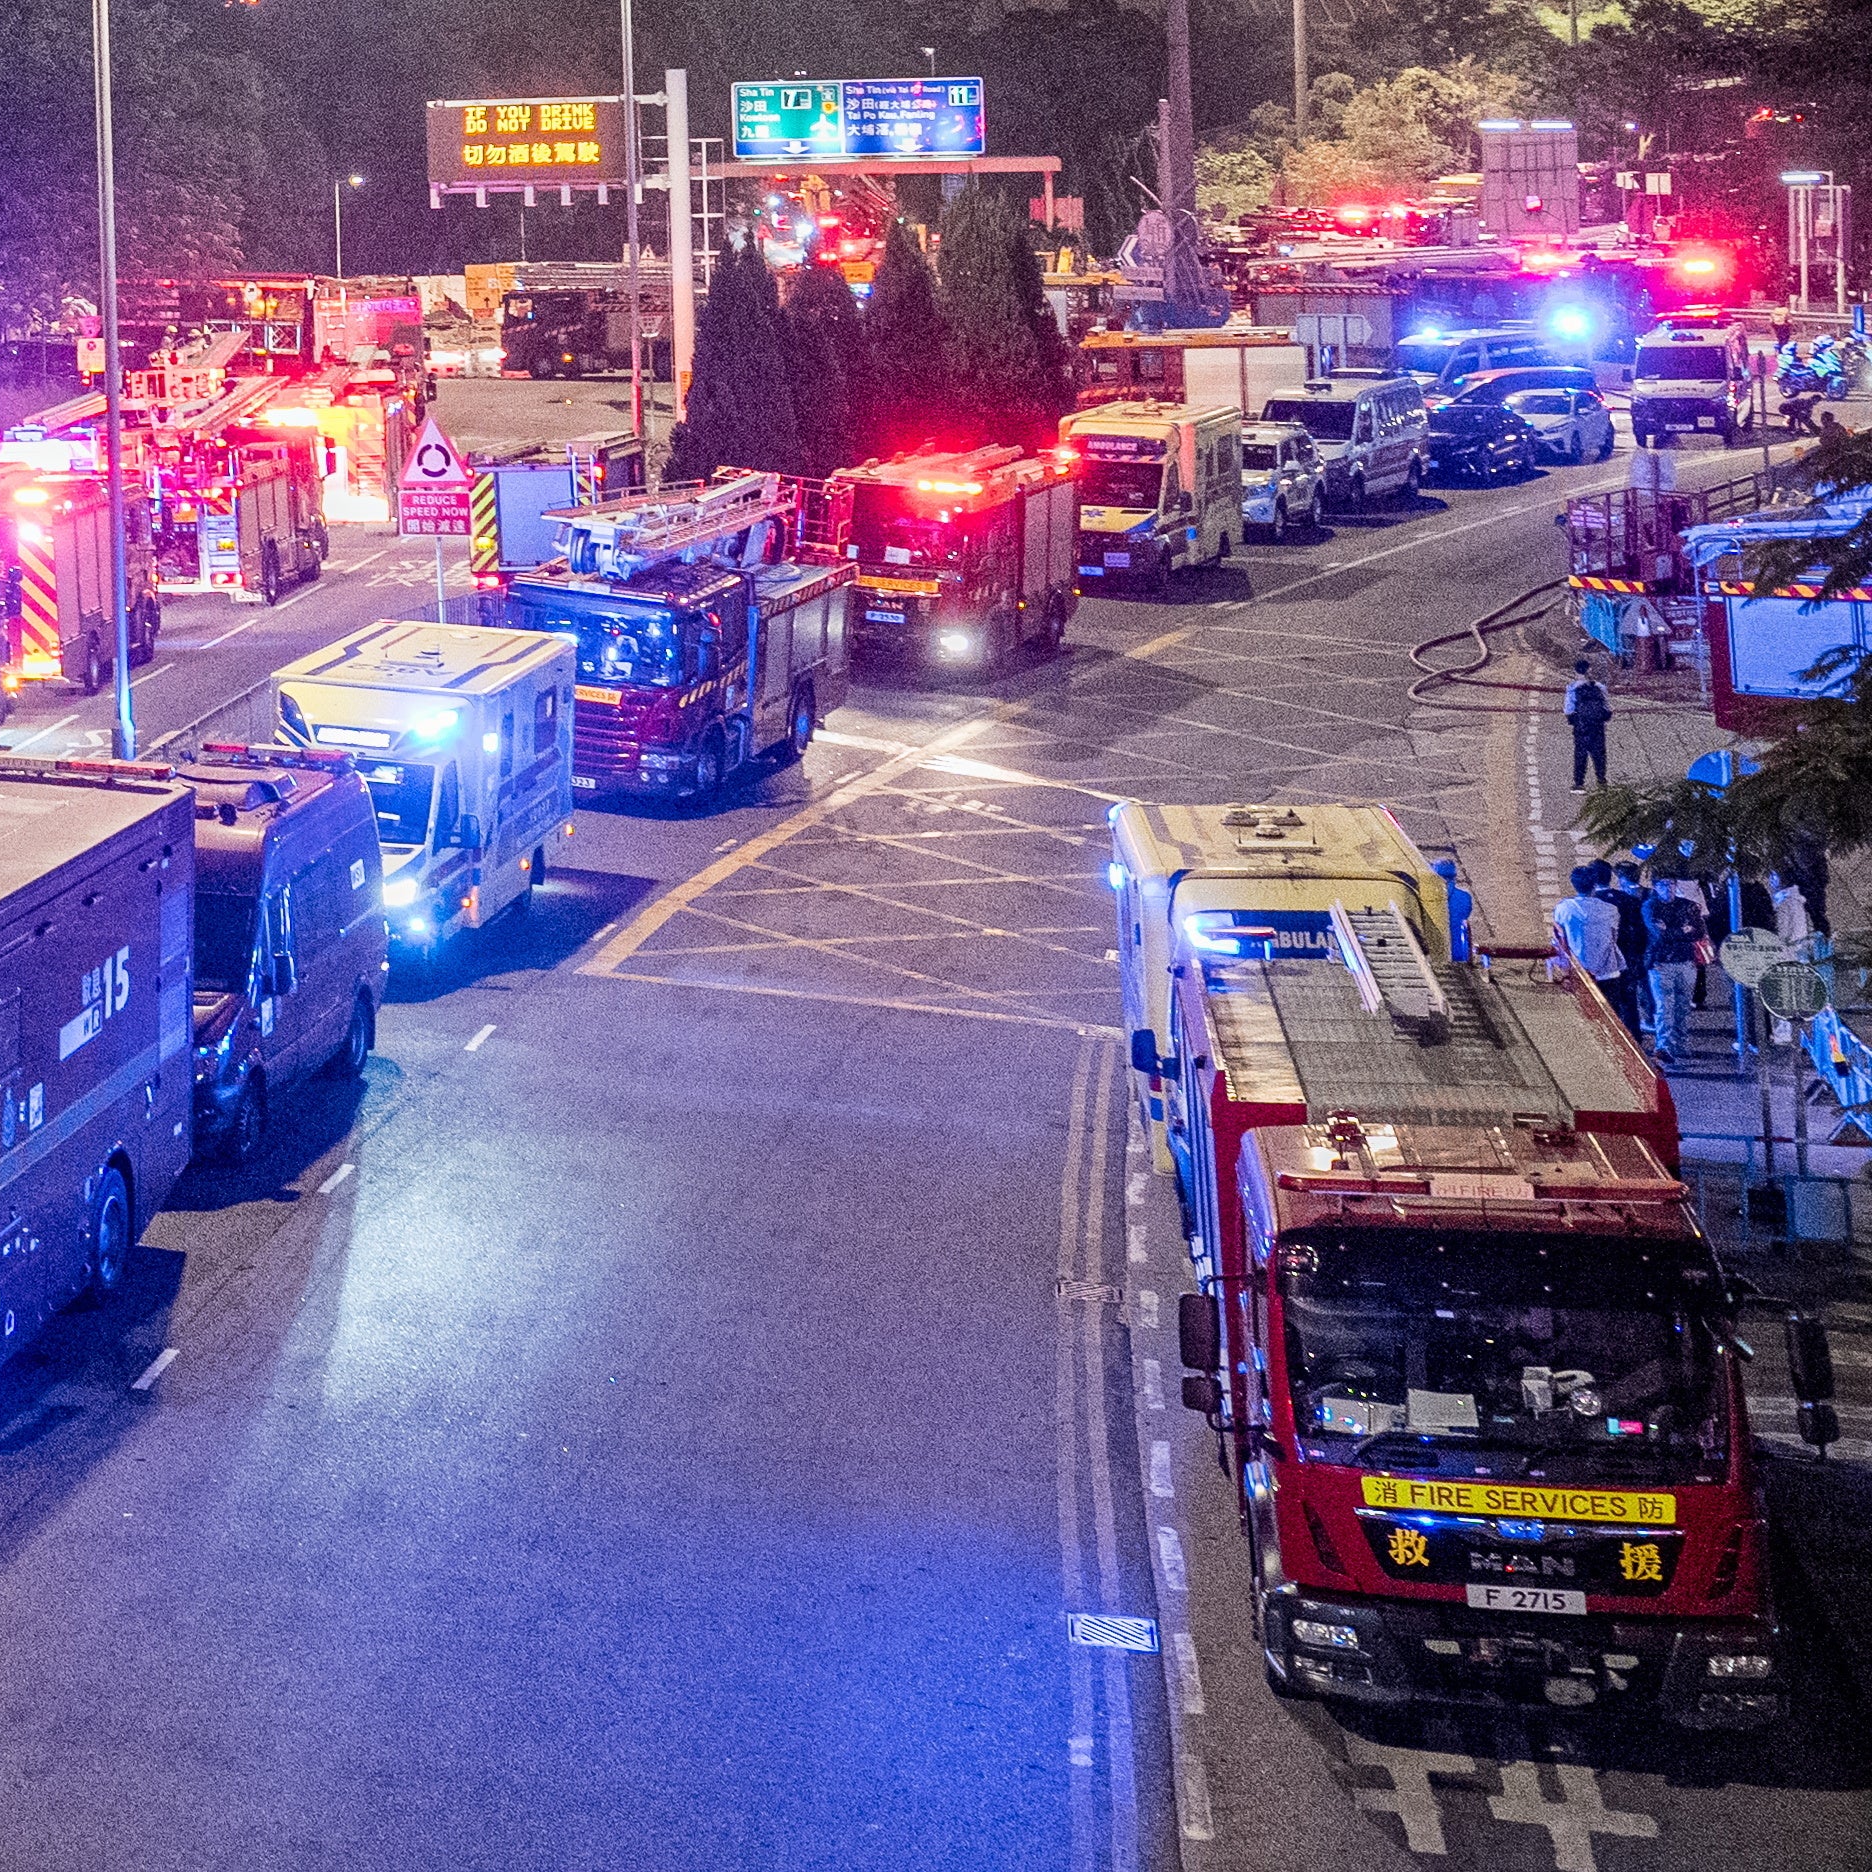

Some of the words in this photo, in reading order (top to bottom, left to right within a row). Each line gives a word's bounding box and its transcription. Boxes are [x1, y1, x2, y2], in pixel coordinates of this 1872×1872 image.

[739, 88, 758, 97] Sha
[759, 87, 774, 96] Tin
[950, 87, 967, 104] 11
[465, 106, 487, 120] IF
[496, 105, 531, 119] YOU
[540, 103, 594, 117] DRINK
[740, 100, 767, 112] 沙田
[465, 119, 487, 133] DO
[496, 118, 531, 132] NOT
[540, 117, 595, 131] DRIVE
[463, 142, 600, 165] 切勿酒後駕駛
[412, 495, 457, 505] REDUCE
[403, 506, 439, 517] SPEED
[441, 507, 469, 517] NOW
[103, 945, 130, 1019] 15
[1460, 1185, 1500, 1197] FIRE
[1374, 1480, 1398, 1504] 消
[1409, 1483, 1474, 1508] FIRE
[1485, 1489, 1627, 1517] SERVICES
[1637, 1496, 1663, 1520] 防
[1388, 1528, 1430, 1567] 救
[1469, 1551, 1575, 1577] MAN
[1618, 1542, 1663, 1581] 援
[1486, 1589, 1500, 1607] F
[1511, 1591, 1566, 1610] 2715
